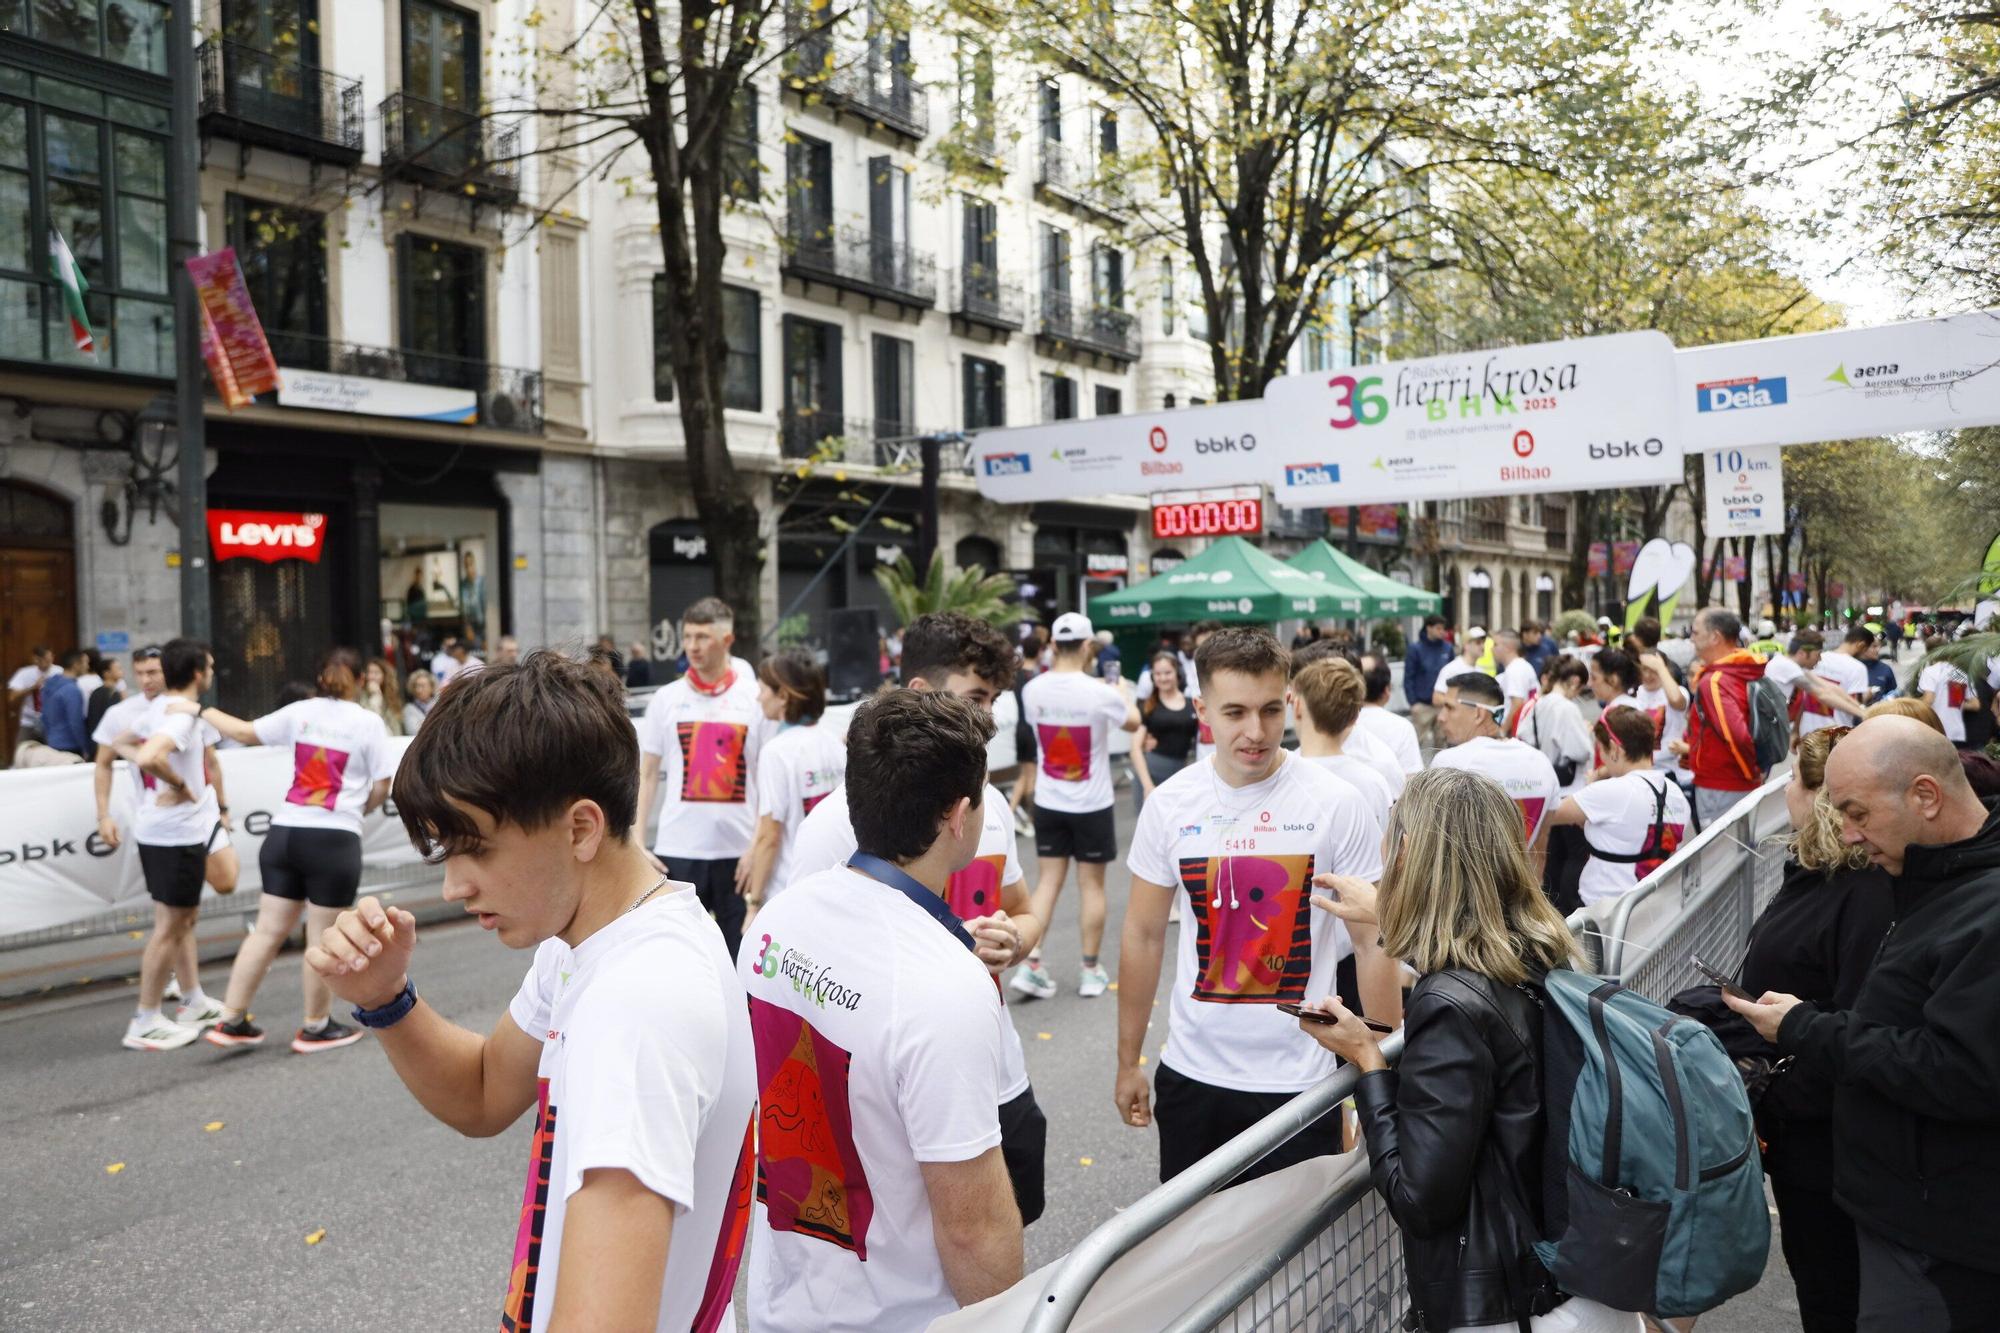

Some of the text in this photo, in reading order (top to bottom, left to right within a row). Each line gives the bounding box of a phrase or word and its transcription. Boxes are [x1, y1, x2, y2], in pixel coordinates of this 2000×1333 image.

[1854, 364, 1899, 378] aena
[1923, 372, 1936, 380] de
[1328, 374, 1390, 430] 36
[1524, 396, 1558, 411] 2025
[1710, 384, 1773, 411] Deia
[1195, 436, 1238, 455] bbk
[1588, 440, 1641, 460] bbk
[1141, 461, 1183, 476] Bilbao
[1713, 449, 1743, 474] 10
[1500, 466, 1552, 482] Bilbao
[1283, 823, 1305, 832] bbk
[1225, 838, 1256, 850] 5418
[753, 933, 781, 979] 36
[1266, 954, 1286, 971] 10
